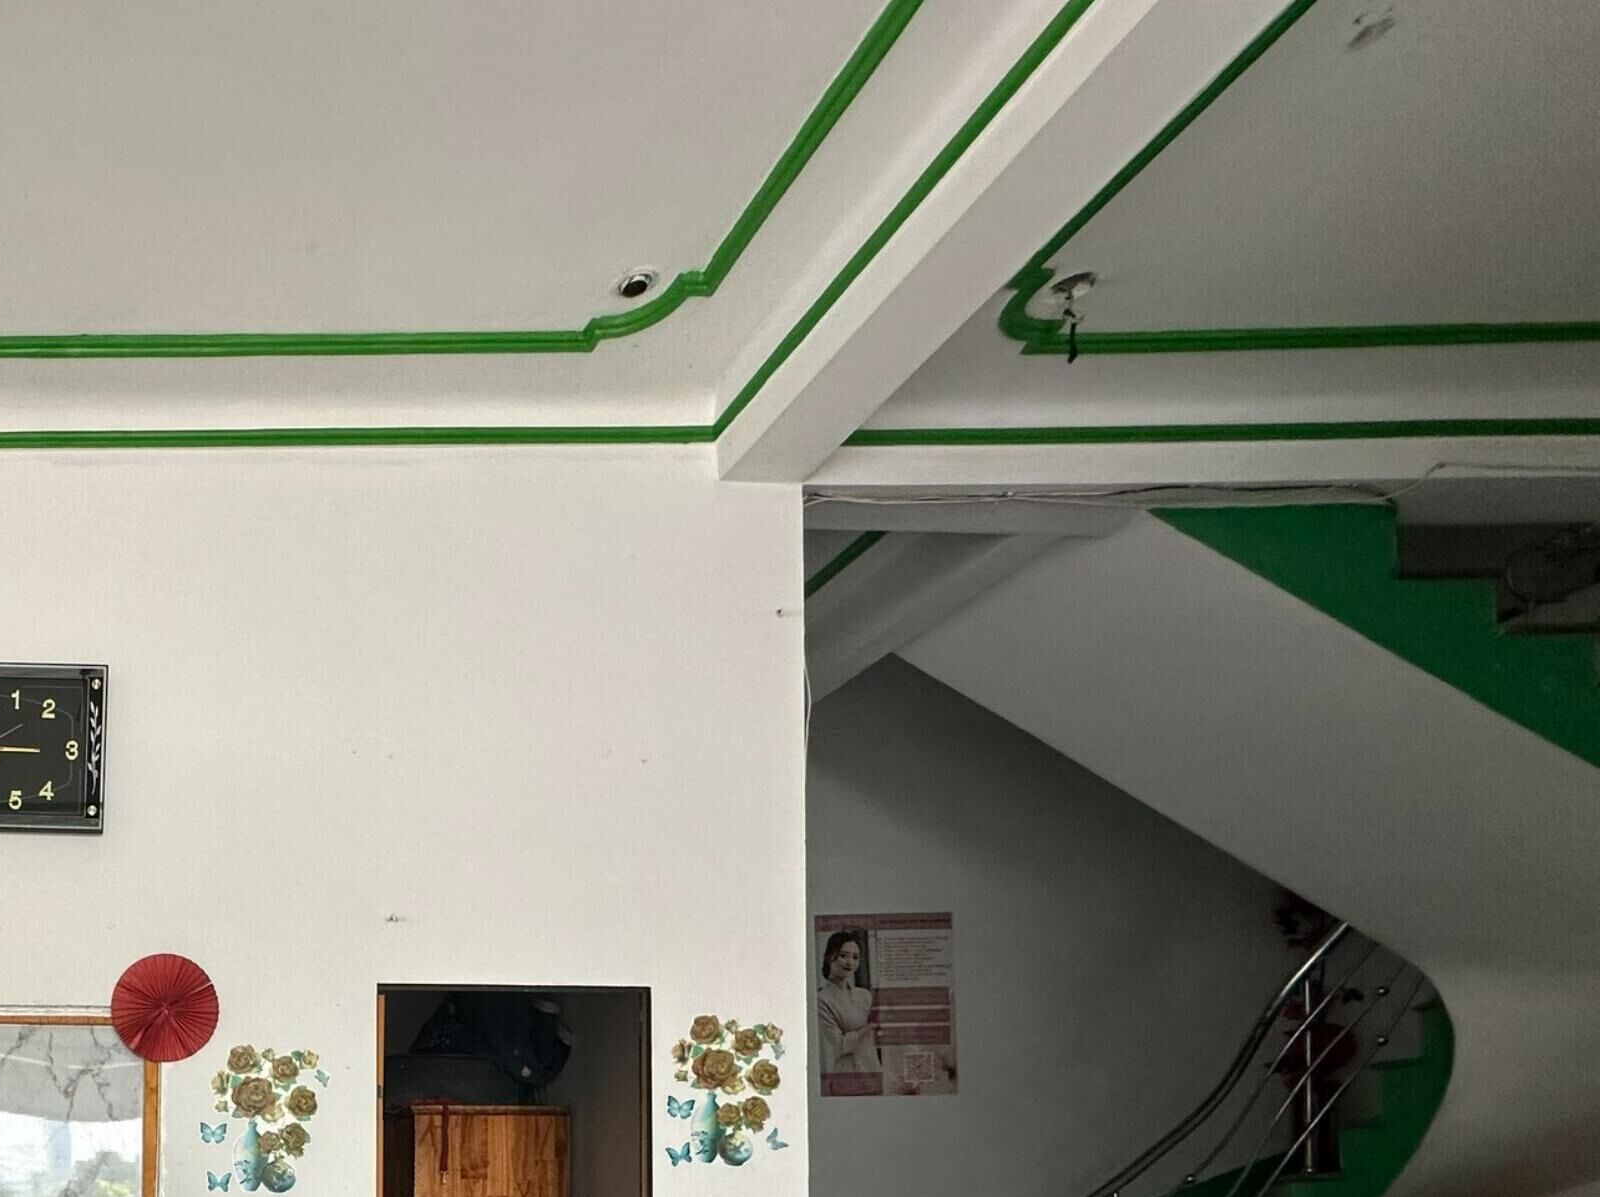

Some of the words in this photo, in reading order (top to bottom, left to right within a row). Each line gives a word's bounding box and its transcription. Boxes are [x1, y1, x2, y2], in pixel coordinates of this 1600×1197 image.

[12, 690, 20, 709] 1
[41, 699, 56, 719] 2
[65, 741, 79, 760] 3
[8, 790, 22, 810] 5
[39, 781, 55, 800] 4
